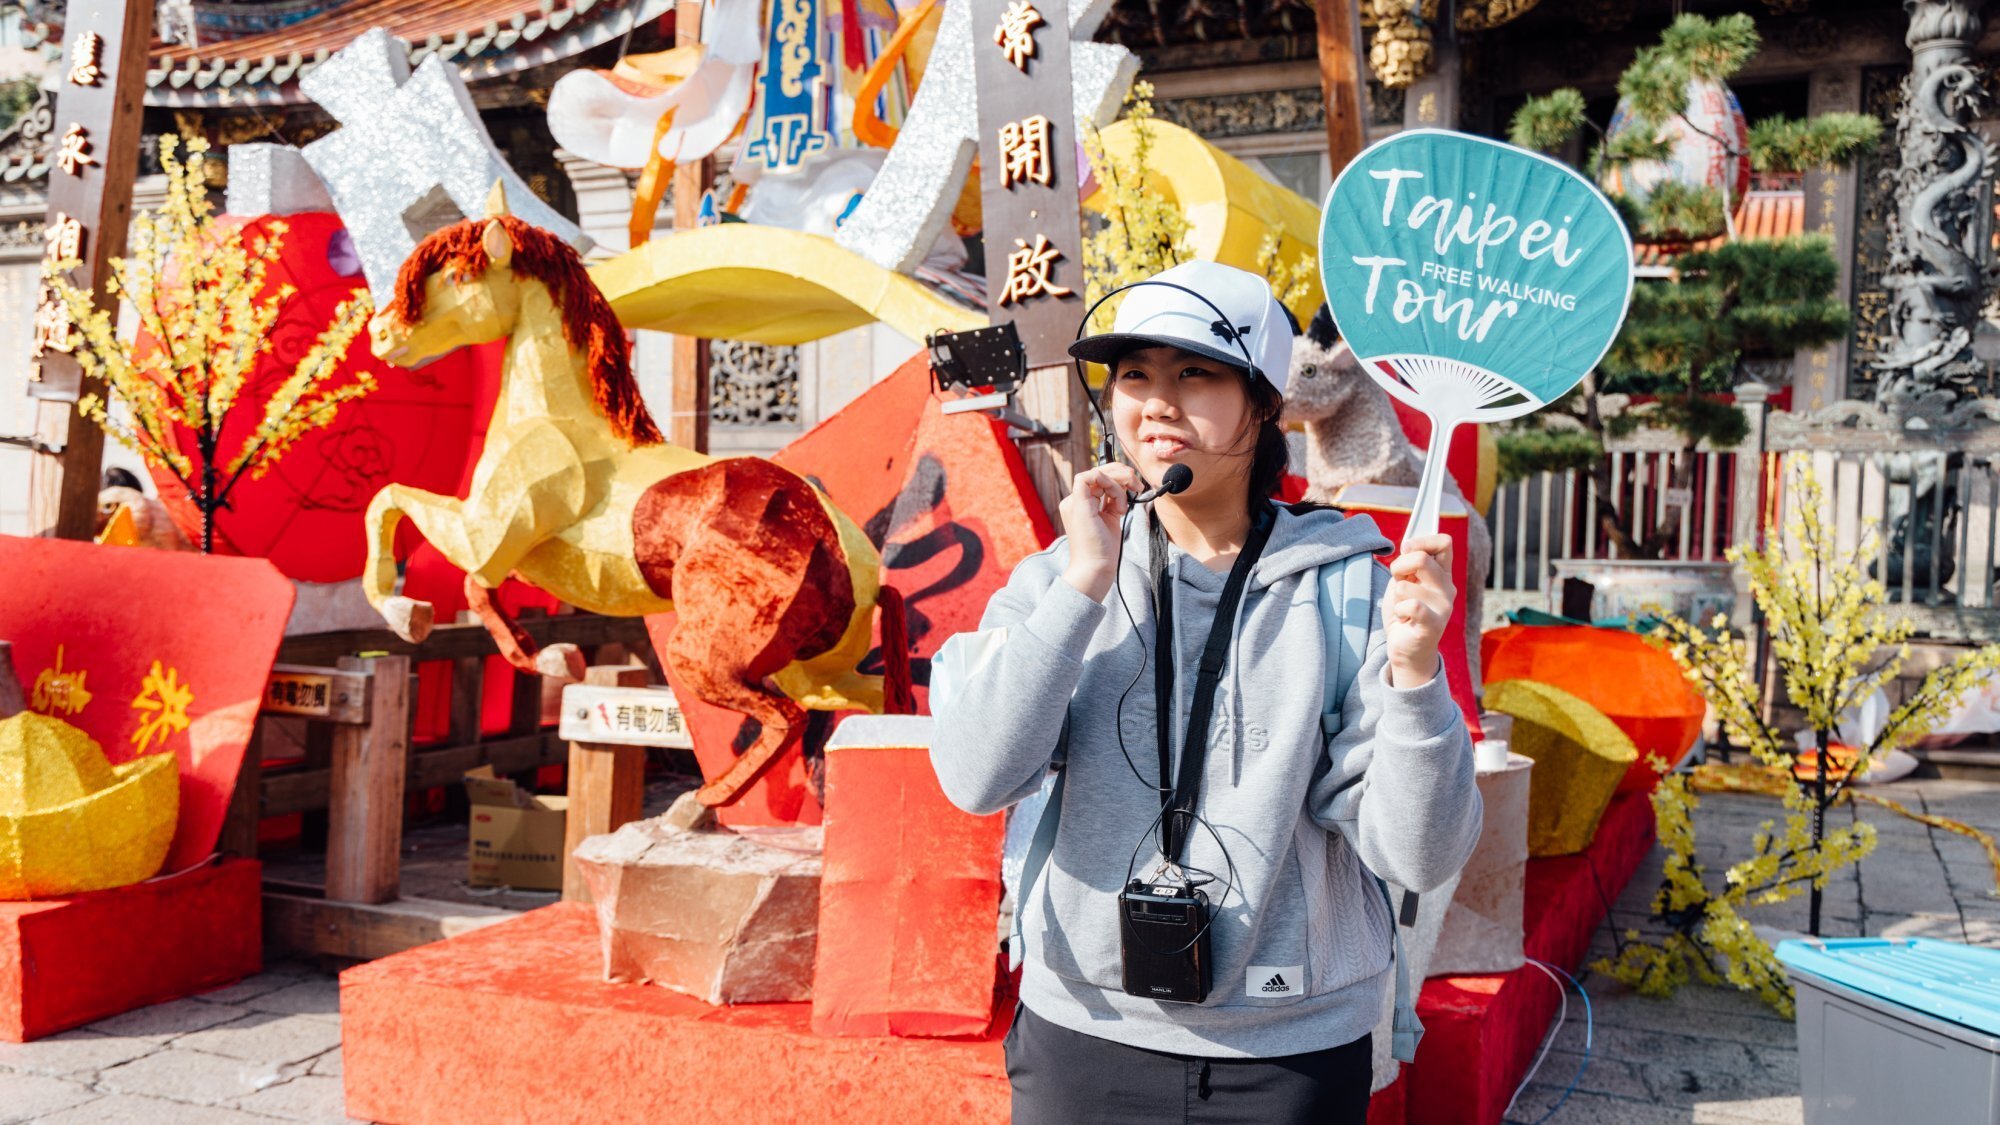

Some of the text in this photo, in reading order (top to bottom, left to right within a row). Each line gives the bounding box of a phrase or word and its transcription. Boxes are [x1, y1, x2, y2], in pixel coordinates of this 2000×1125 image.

[993, 0, 1070, 305] 常開啟
[1369, 168, 1582, 268] Taipei
[1352, 255, 1518, 343] Tour
[1421, 261, 1576, 311] FREE WALKING
[1261, 985, 1290, 993] adidas
